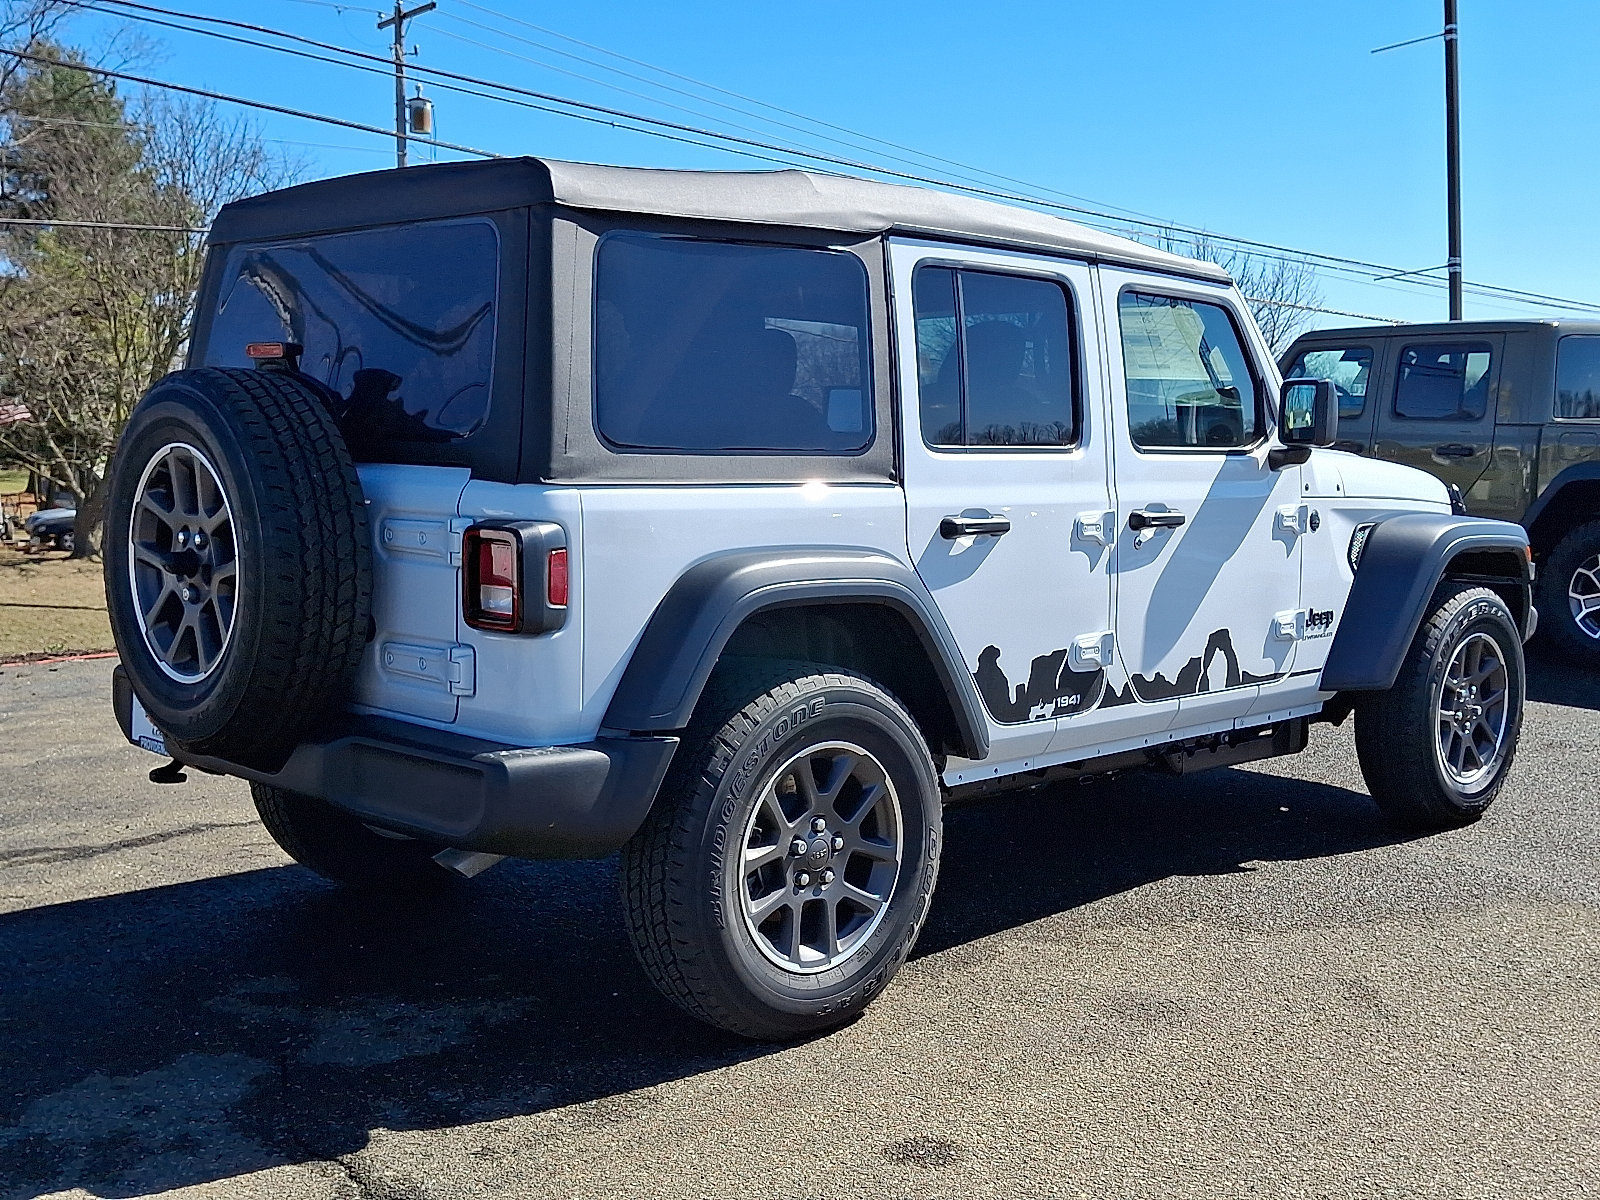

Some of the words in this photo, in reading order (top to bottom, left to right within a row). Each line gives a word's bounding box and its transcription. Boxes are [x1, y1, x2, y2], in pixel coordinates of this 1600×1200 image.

[1306, 608, 1334, 628] Jeep
[1056, 694, 1081, 708] 1941
[709, 697, 826, 929] BRIDGESTONE
